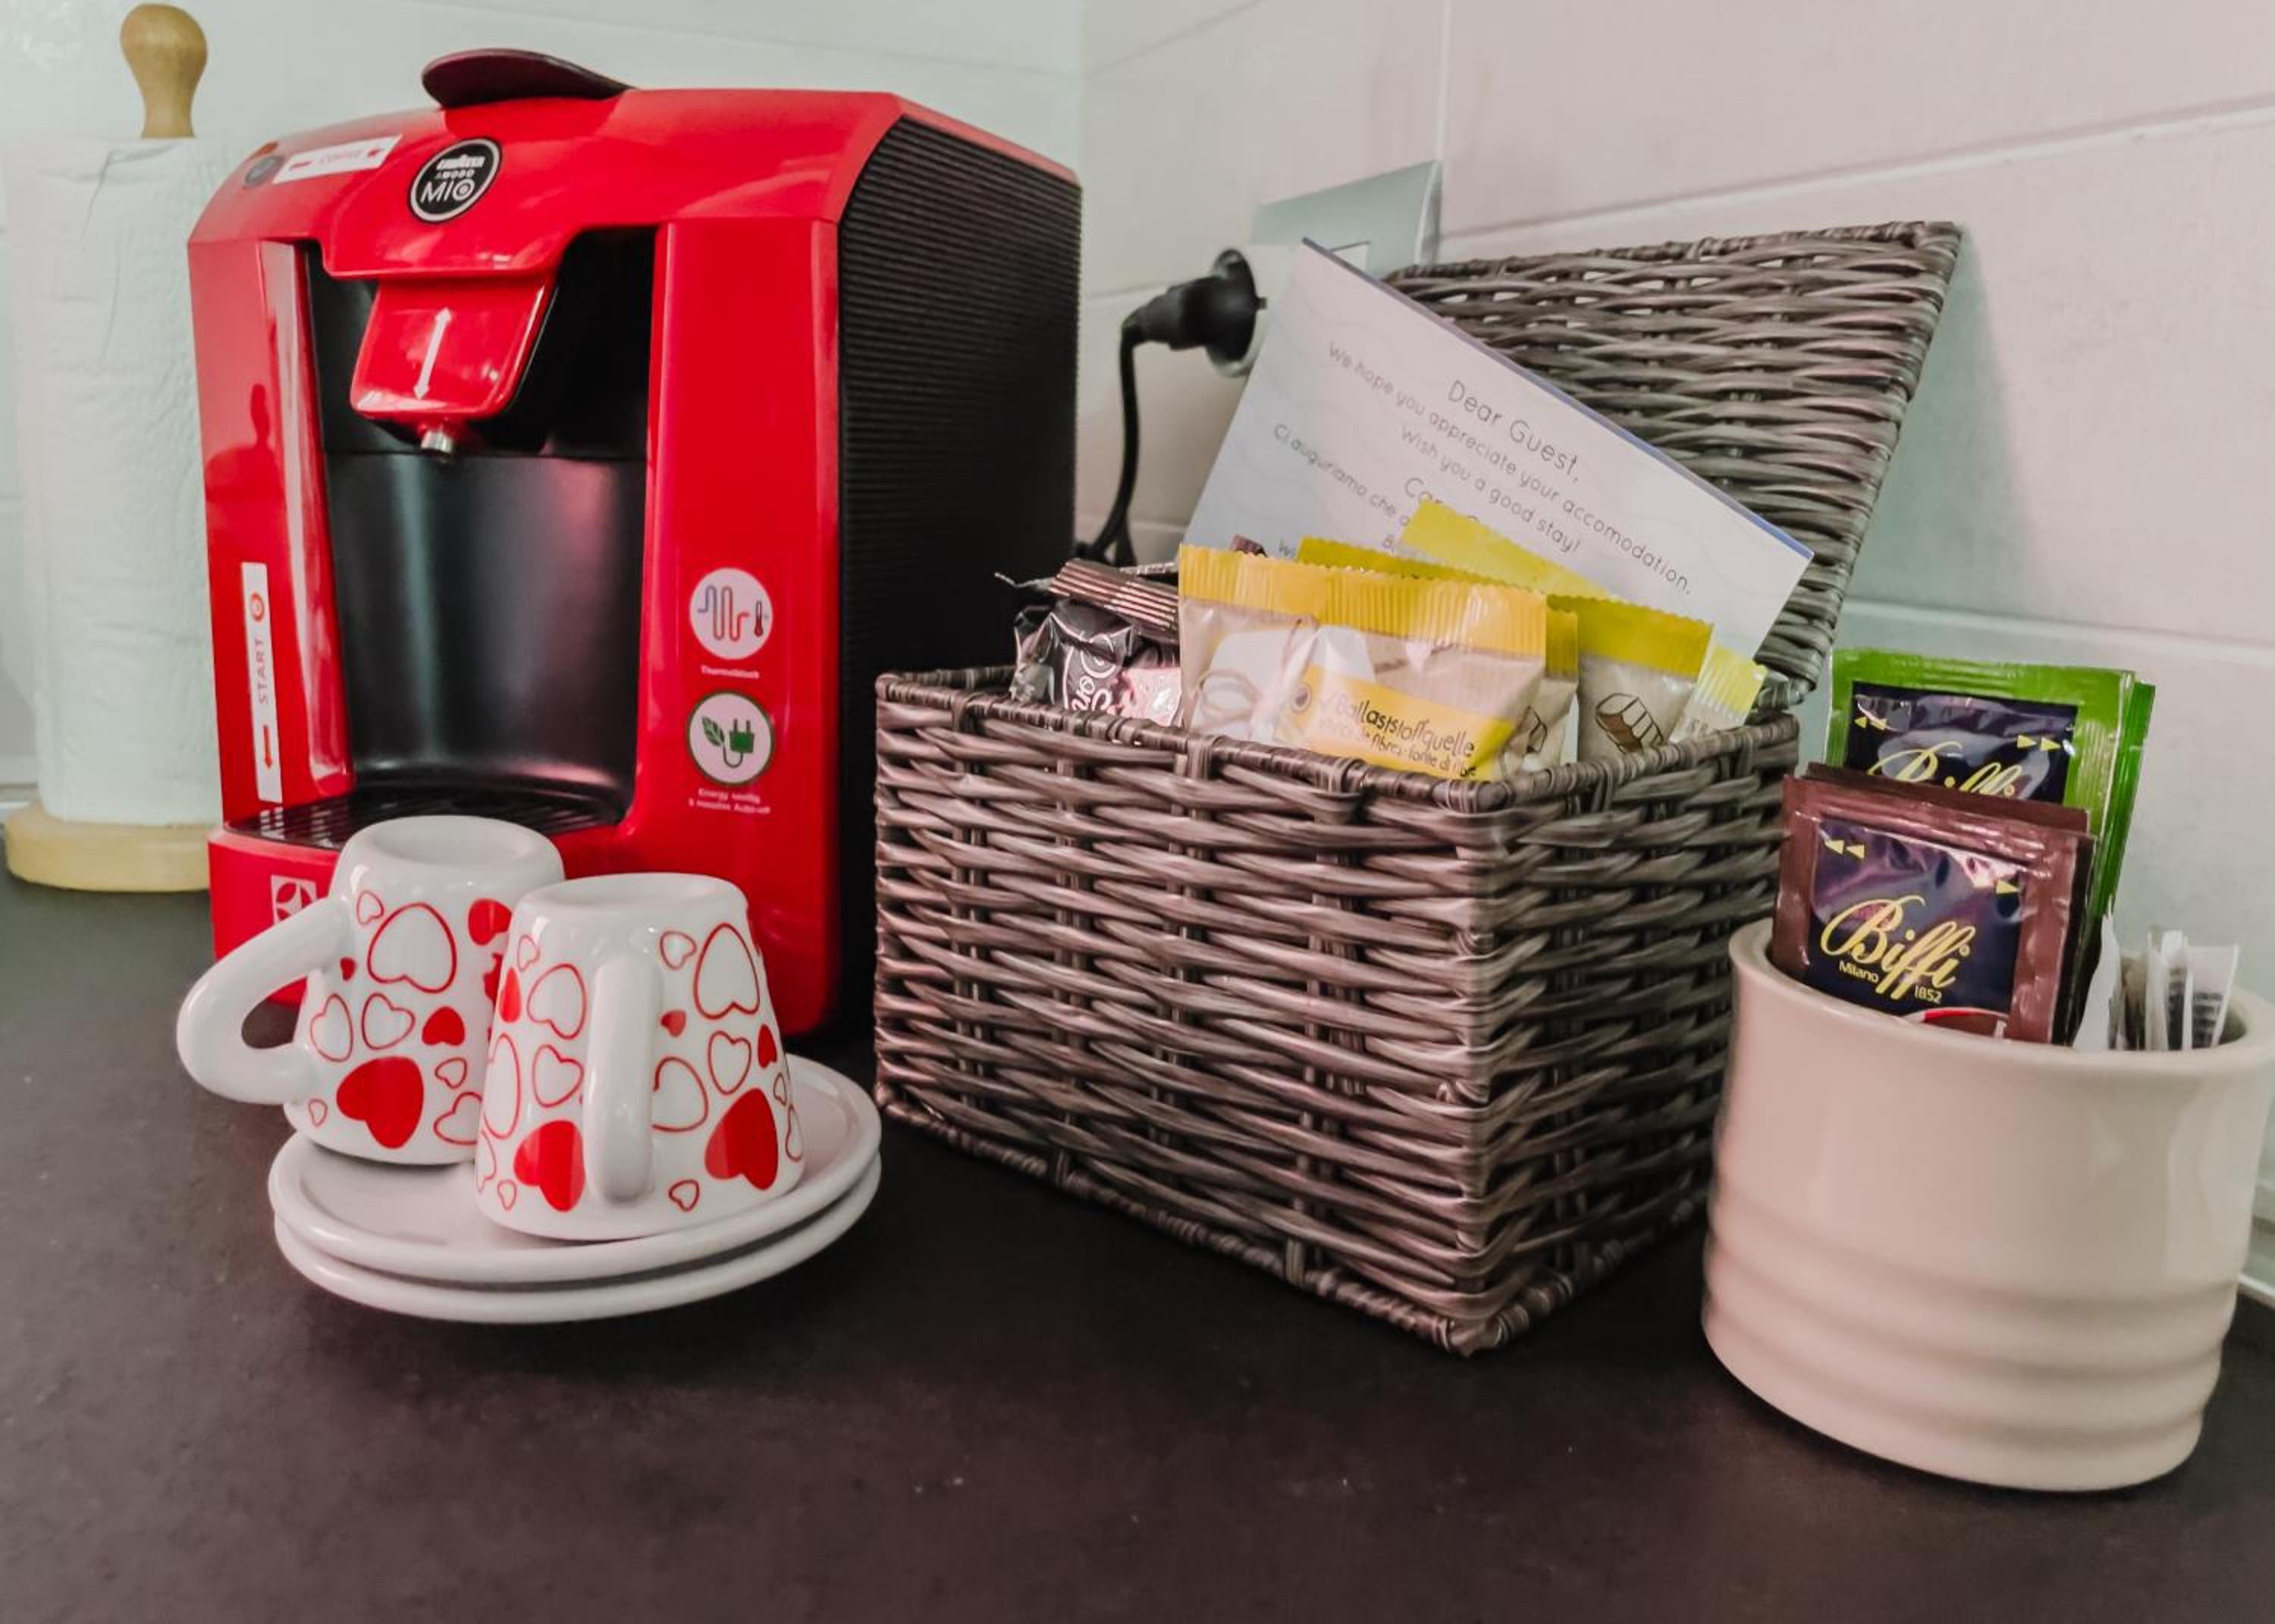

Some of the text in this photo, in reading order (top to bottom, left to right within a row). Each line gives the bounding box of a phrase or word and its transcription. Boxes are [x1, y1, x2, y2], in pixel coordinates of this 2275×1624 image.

[420, 178, 475, 204] MIO
[1329, 340, 1690, 595] We hope you appreciate your accomodation.
[1448, 379, 1578, 484] Dear Guest,
[1291, 437, 1367, 497] auguriamo
[1369, 494, 1396, 518] che
[1440, 455, 1471, 481] you
[1474, 478, 1486, 491] a
[1489, 488, 1536, 523] good
[254, 637, 268, 704] START
[1821, 894, 1976, 1000] Biffi
[1839, 960, 1943, 1005] Milano 1852
